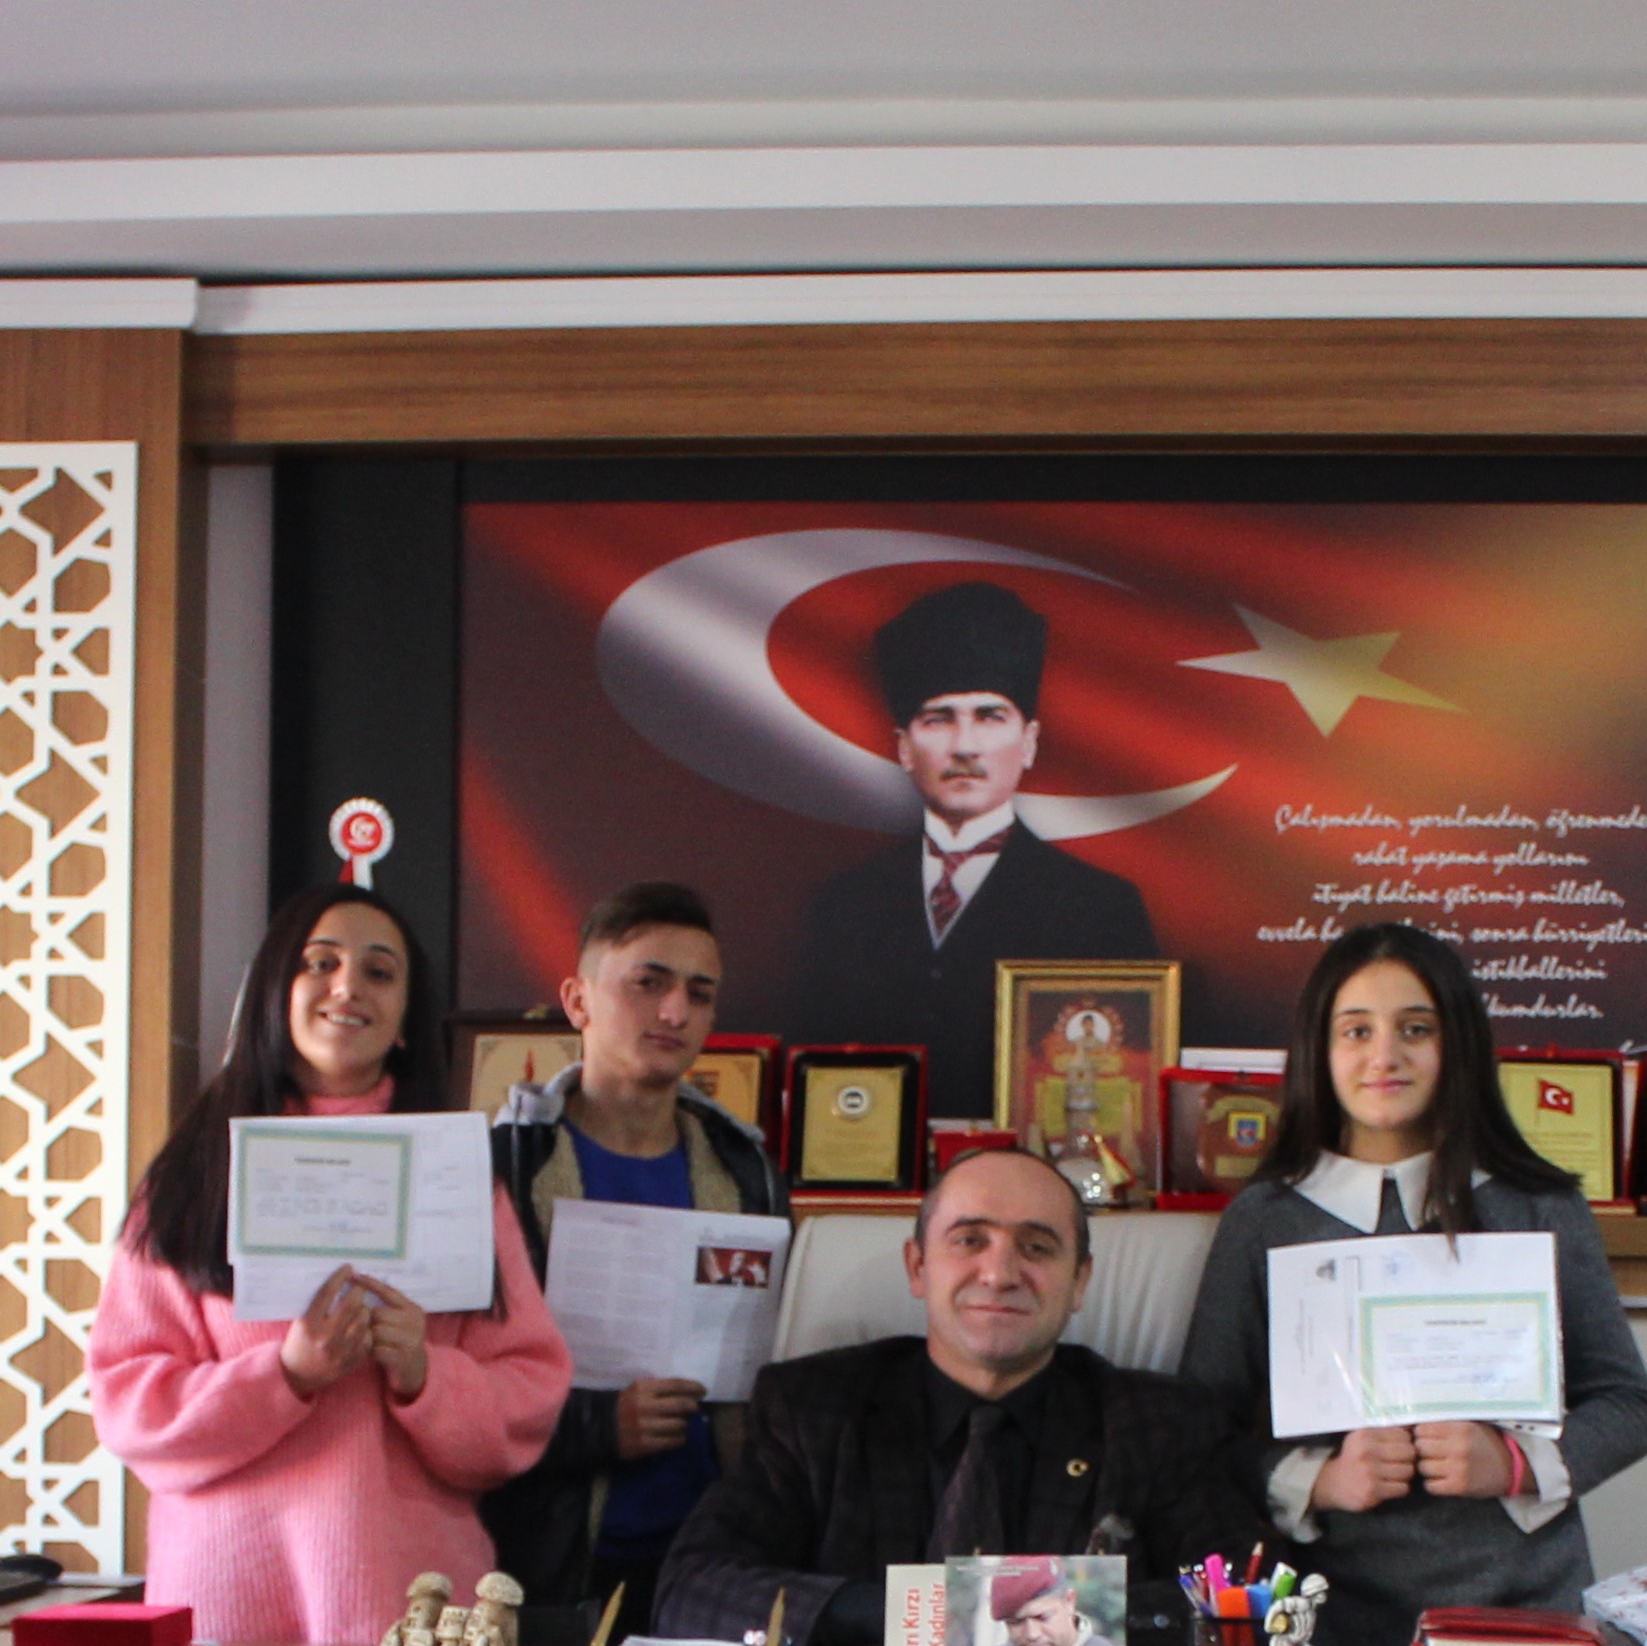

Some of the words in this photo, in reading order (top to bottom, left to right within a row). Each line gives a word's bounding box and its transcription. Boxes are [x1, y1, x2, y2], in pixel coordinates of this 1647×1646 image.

[1274, 803, 1402, 834] Çalışmadan,
[1408, 803, 1540, 838] yorulmadan,
[1352, 841, 1408, 866] rahat
[1411, 851, 1489, 875] yaşama
[1528, 880, 1625, 908] milletler,
[1469, 926, 1529, 943] sonra
